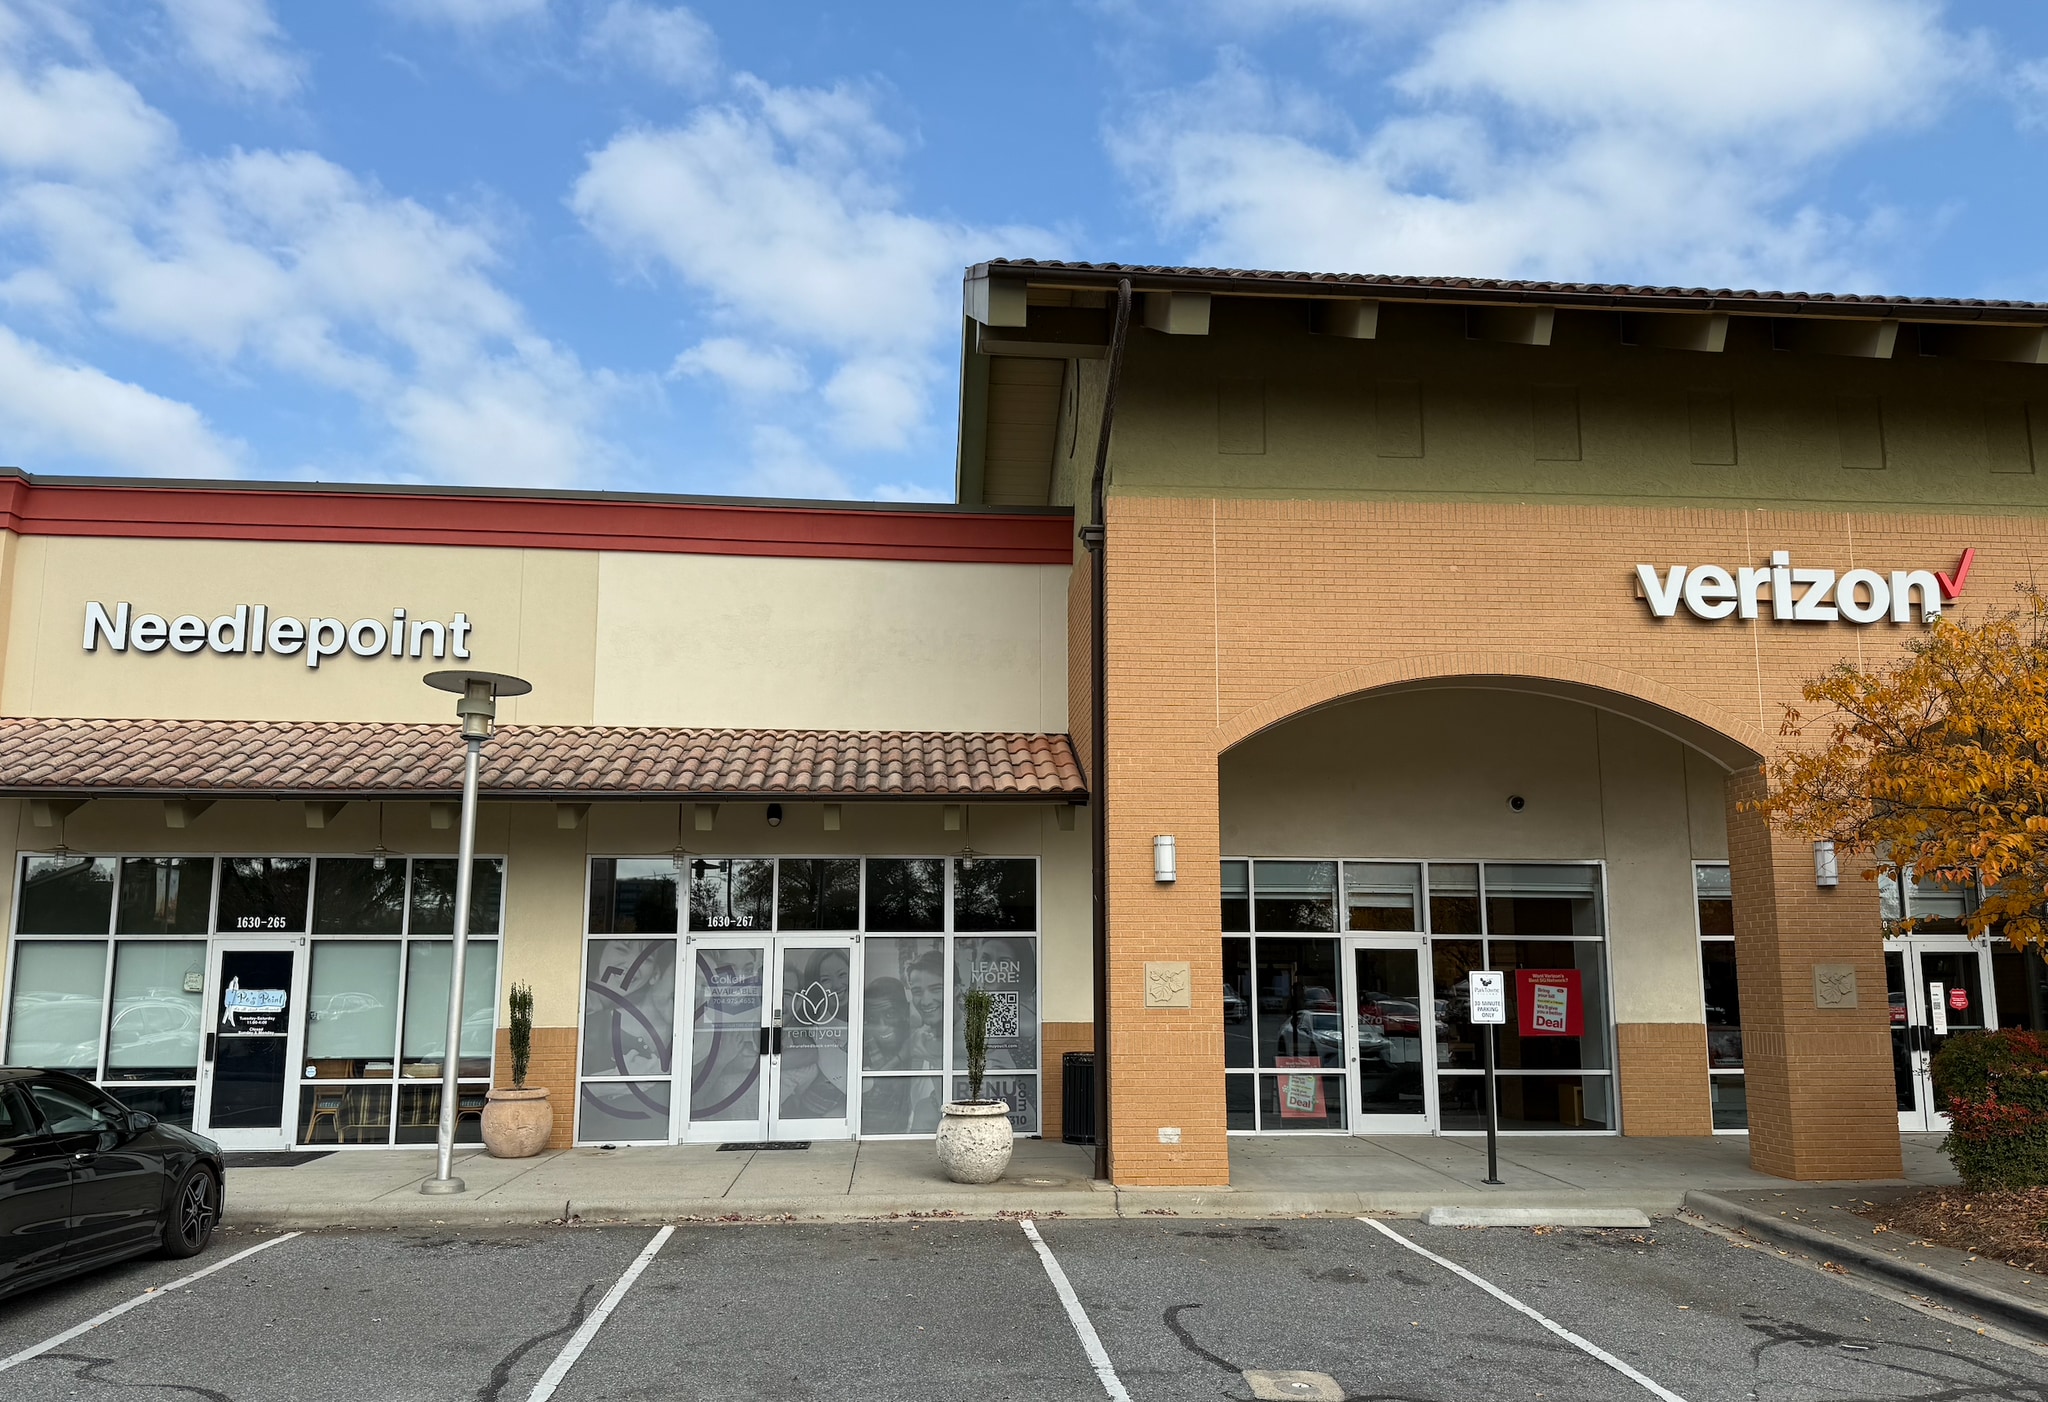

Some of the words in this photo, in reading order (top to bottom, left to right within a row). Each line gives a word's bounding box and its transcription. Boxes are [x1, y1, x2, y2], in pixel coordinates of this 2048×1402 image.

[1636, 550, 1942, 624] verizon
[82, 601, 472, 669] Needlepoint
[236, 916, 286, 928] 1630-265
[707, 915, 754, 927] 1630-267
[971, 961, 1020, 973] LEARN
[971, 971, 1020, 984] MORE:
[711, 987, 758, 995] AVAILABLE
[1536, 1015, 1563, 1029] Deal
[956, 1080, 1017, 1099] RNU
[1289, 1096, 1311, 1109] Deal
